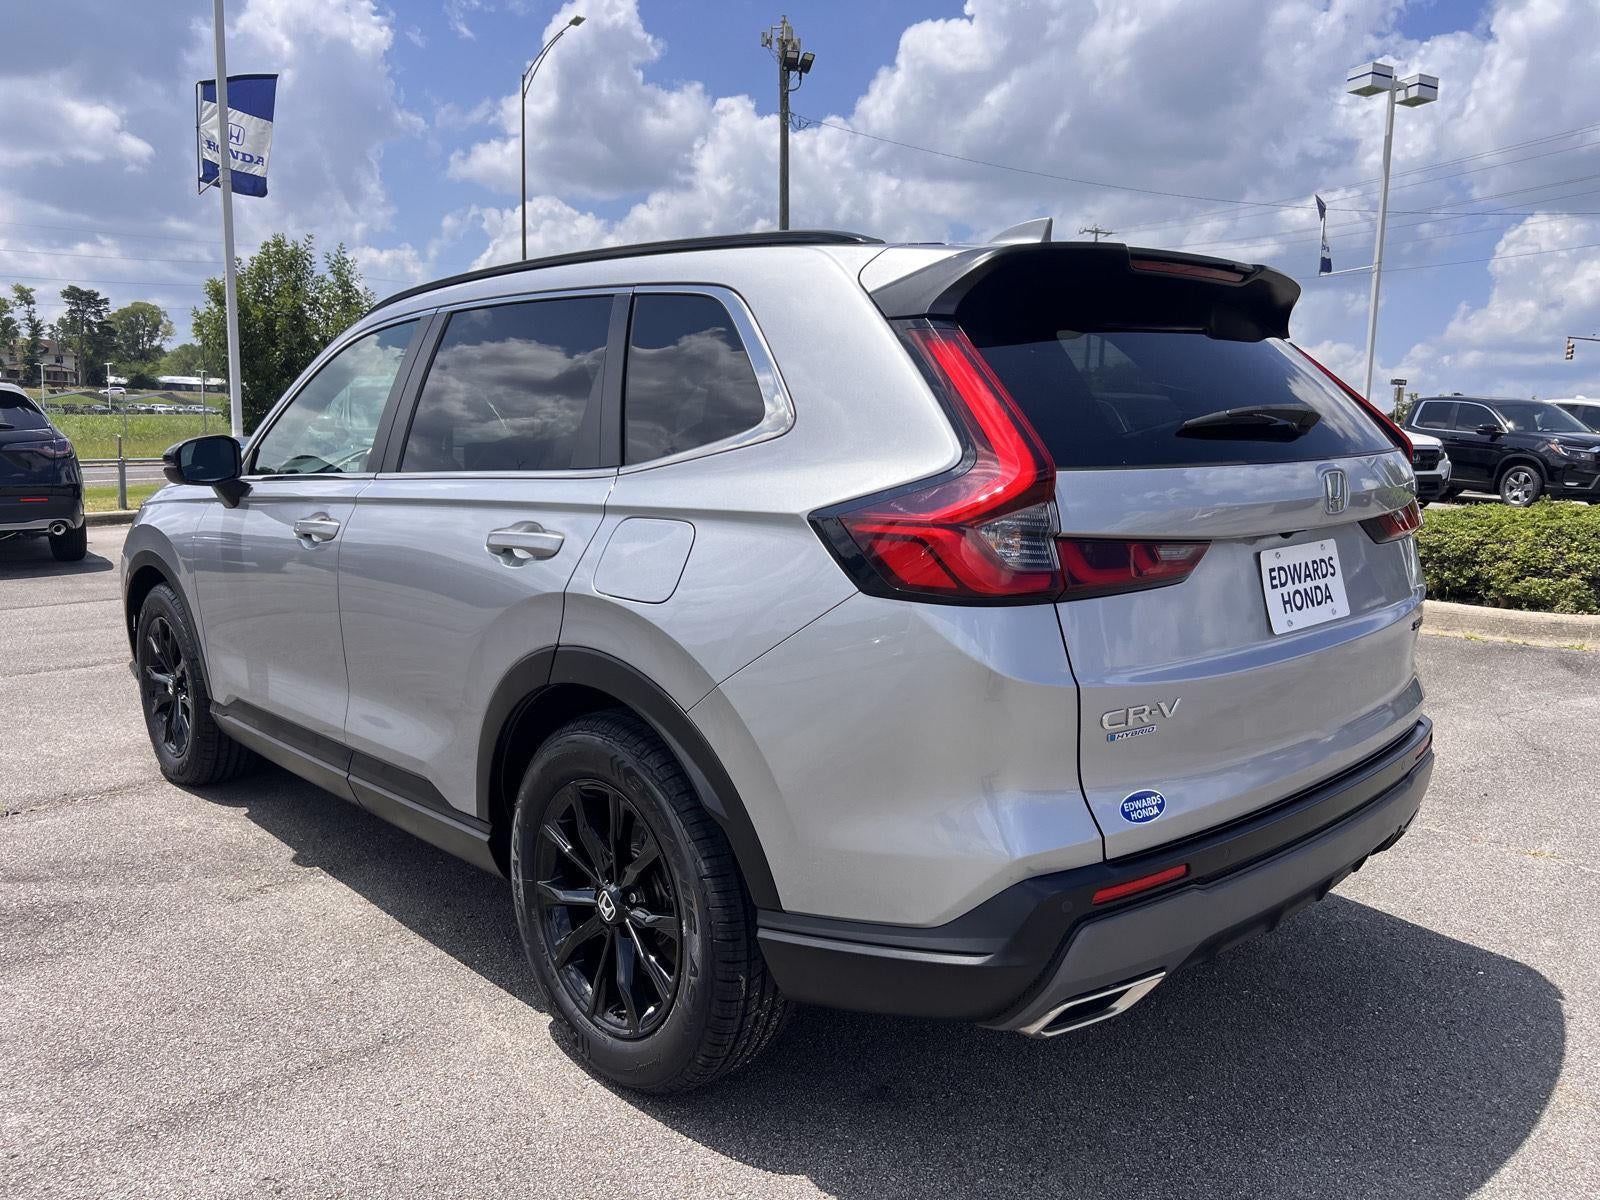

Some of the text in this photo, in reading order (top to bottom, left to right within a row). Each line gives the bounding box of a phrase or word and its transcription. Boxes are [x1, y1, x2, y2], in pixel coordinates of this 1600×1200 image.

[205, 139, 265, 167] HNDA
[1268, 556, 1336, 590] EDWARDS
[1280, 582, 1334, 615] HONDA
[1100, 696, 1182, 730] CR-V
[1115, 725, 1156, 741] HYBRID
[1123, 794, 1162, 813] EDWARDS
[1130, 805, 1160, 821] HONDA
